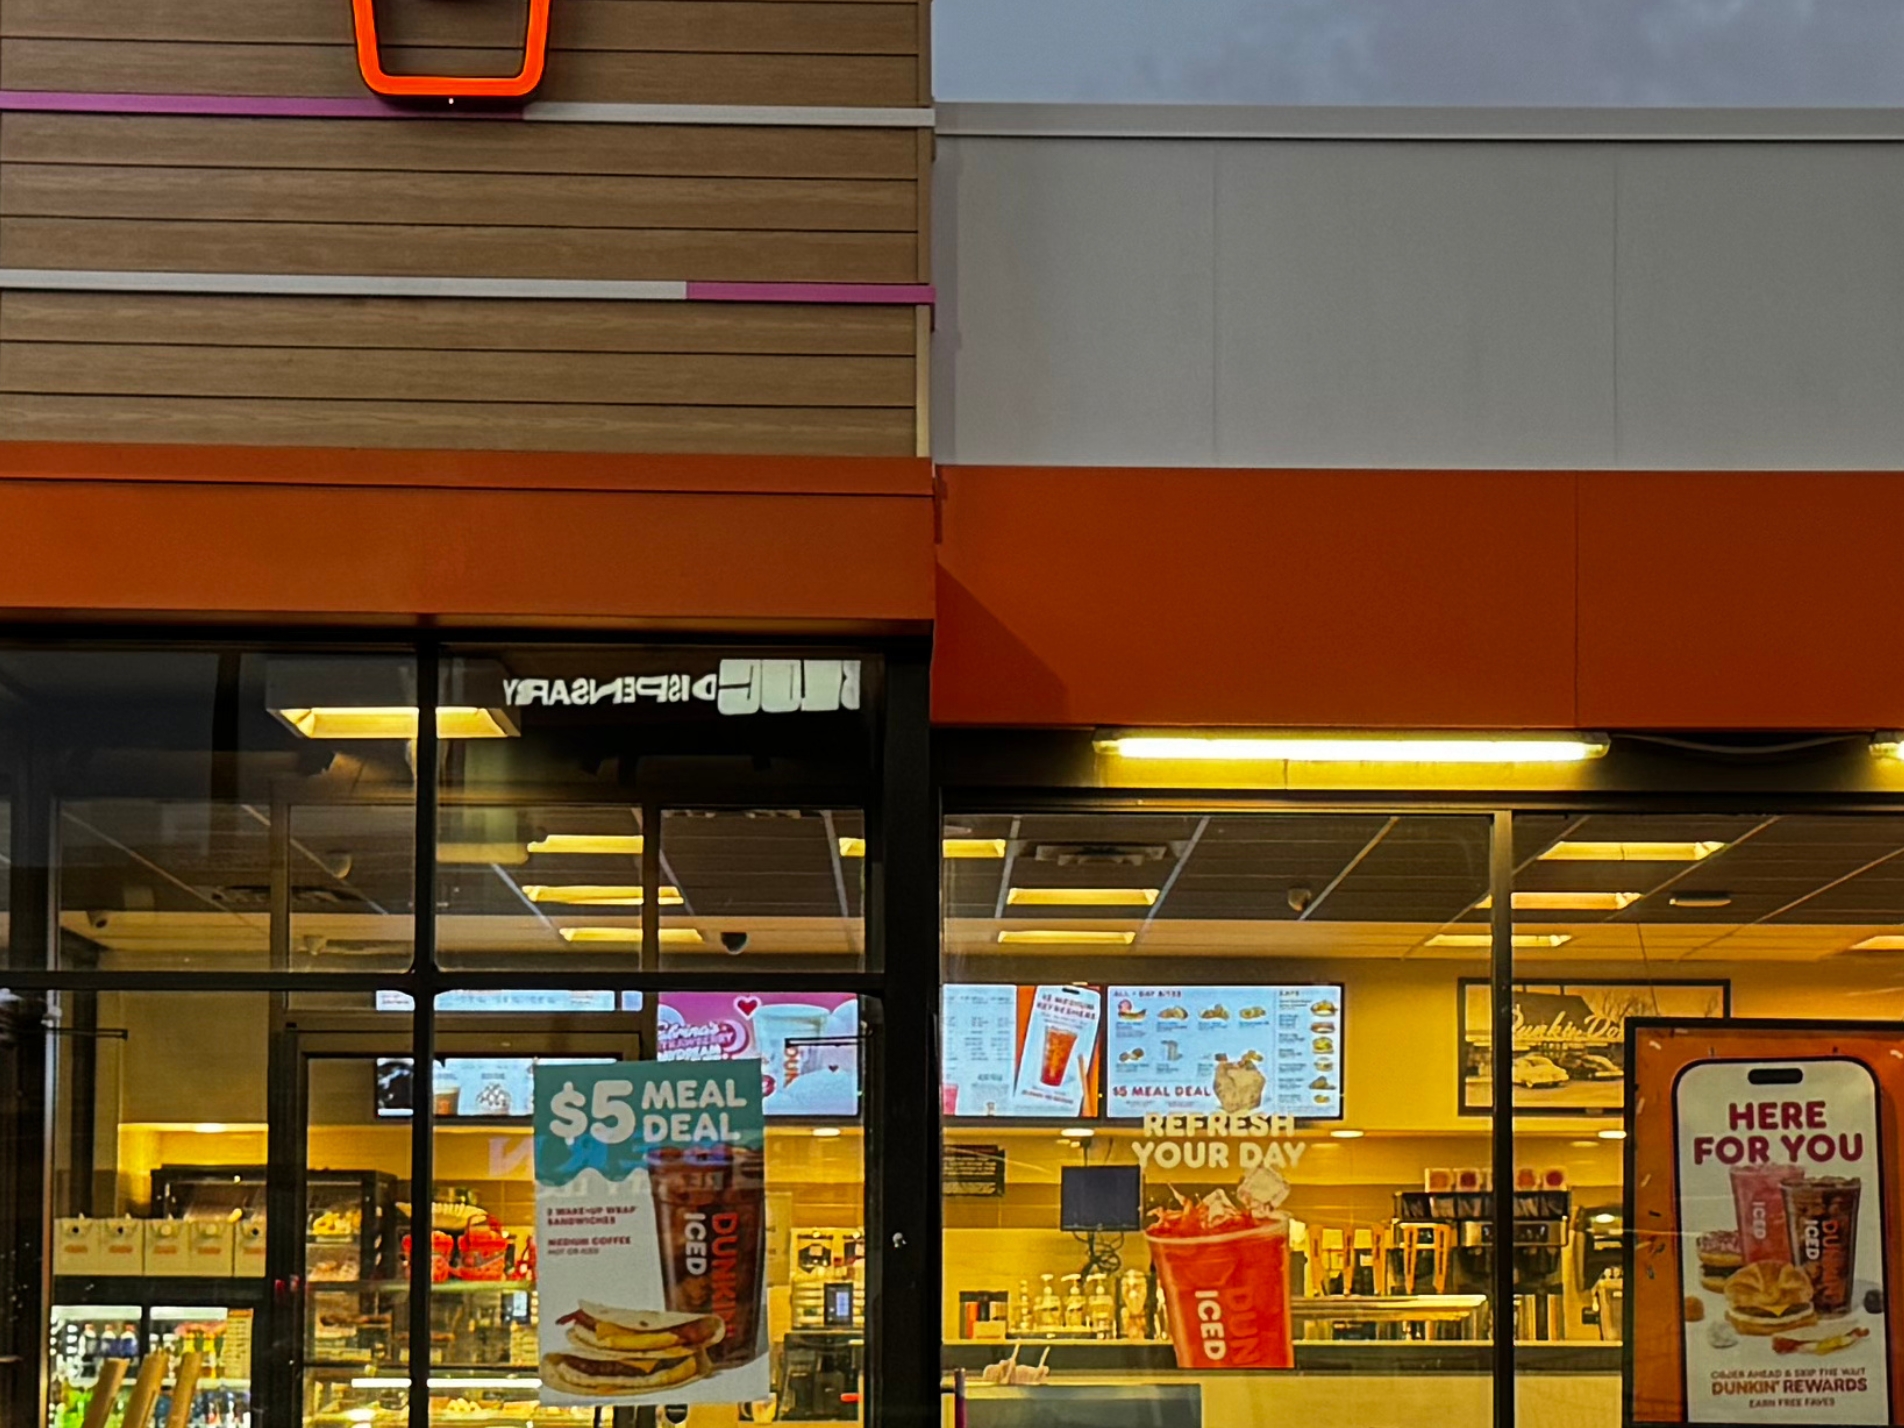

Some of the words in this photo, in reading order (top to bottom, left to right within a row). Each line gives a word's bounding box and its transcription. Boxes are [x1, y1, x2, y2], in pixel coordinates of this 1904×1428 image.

[1132, 1086, 1170, 1097] MEAL
[1175, 1086, 1211, 1097] DEAL
[549, 1080, 636, 1146] $5
[641, 1079, 747, 1110] MEAL
[642, 1112, 742, 1143] DEAL
[1143, 1112, 1295, 1137] REFRESH
[1728, 1101, 1827, 1131] HERE
[1131, 1141, 1229, 1169] YOUR
[1239, 1141, 1306, 1169] DAY
[1694, 1135, 1771, 1165] FOR
[1780, 1133, 1864, 1162] YOU
[1752, 1202, 1767, 1240] ICED
[591, 1236, 631, 1246] COFFEE
[683, 1213, 707, 1275] ICED
[1804, 1220, 1820, 1260] ICED
[1194, 1290, 1227, 1361] ICED
[1712, 1380, 1780, 1395] DUNKIN'
[1783, 1378, 1868, 1393] REWARDS
[1778, 1398, 1802, 1407] FREE
